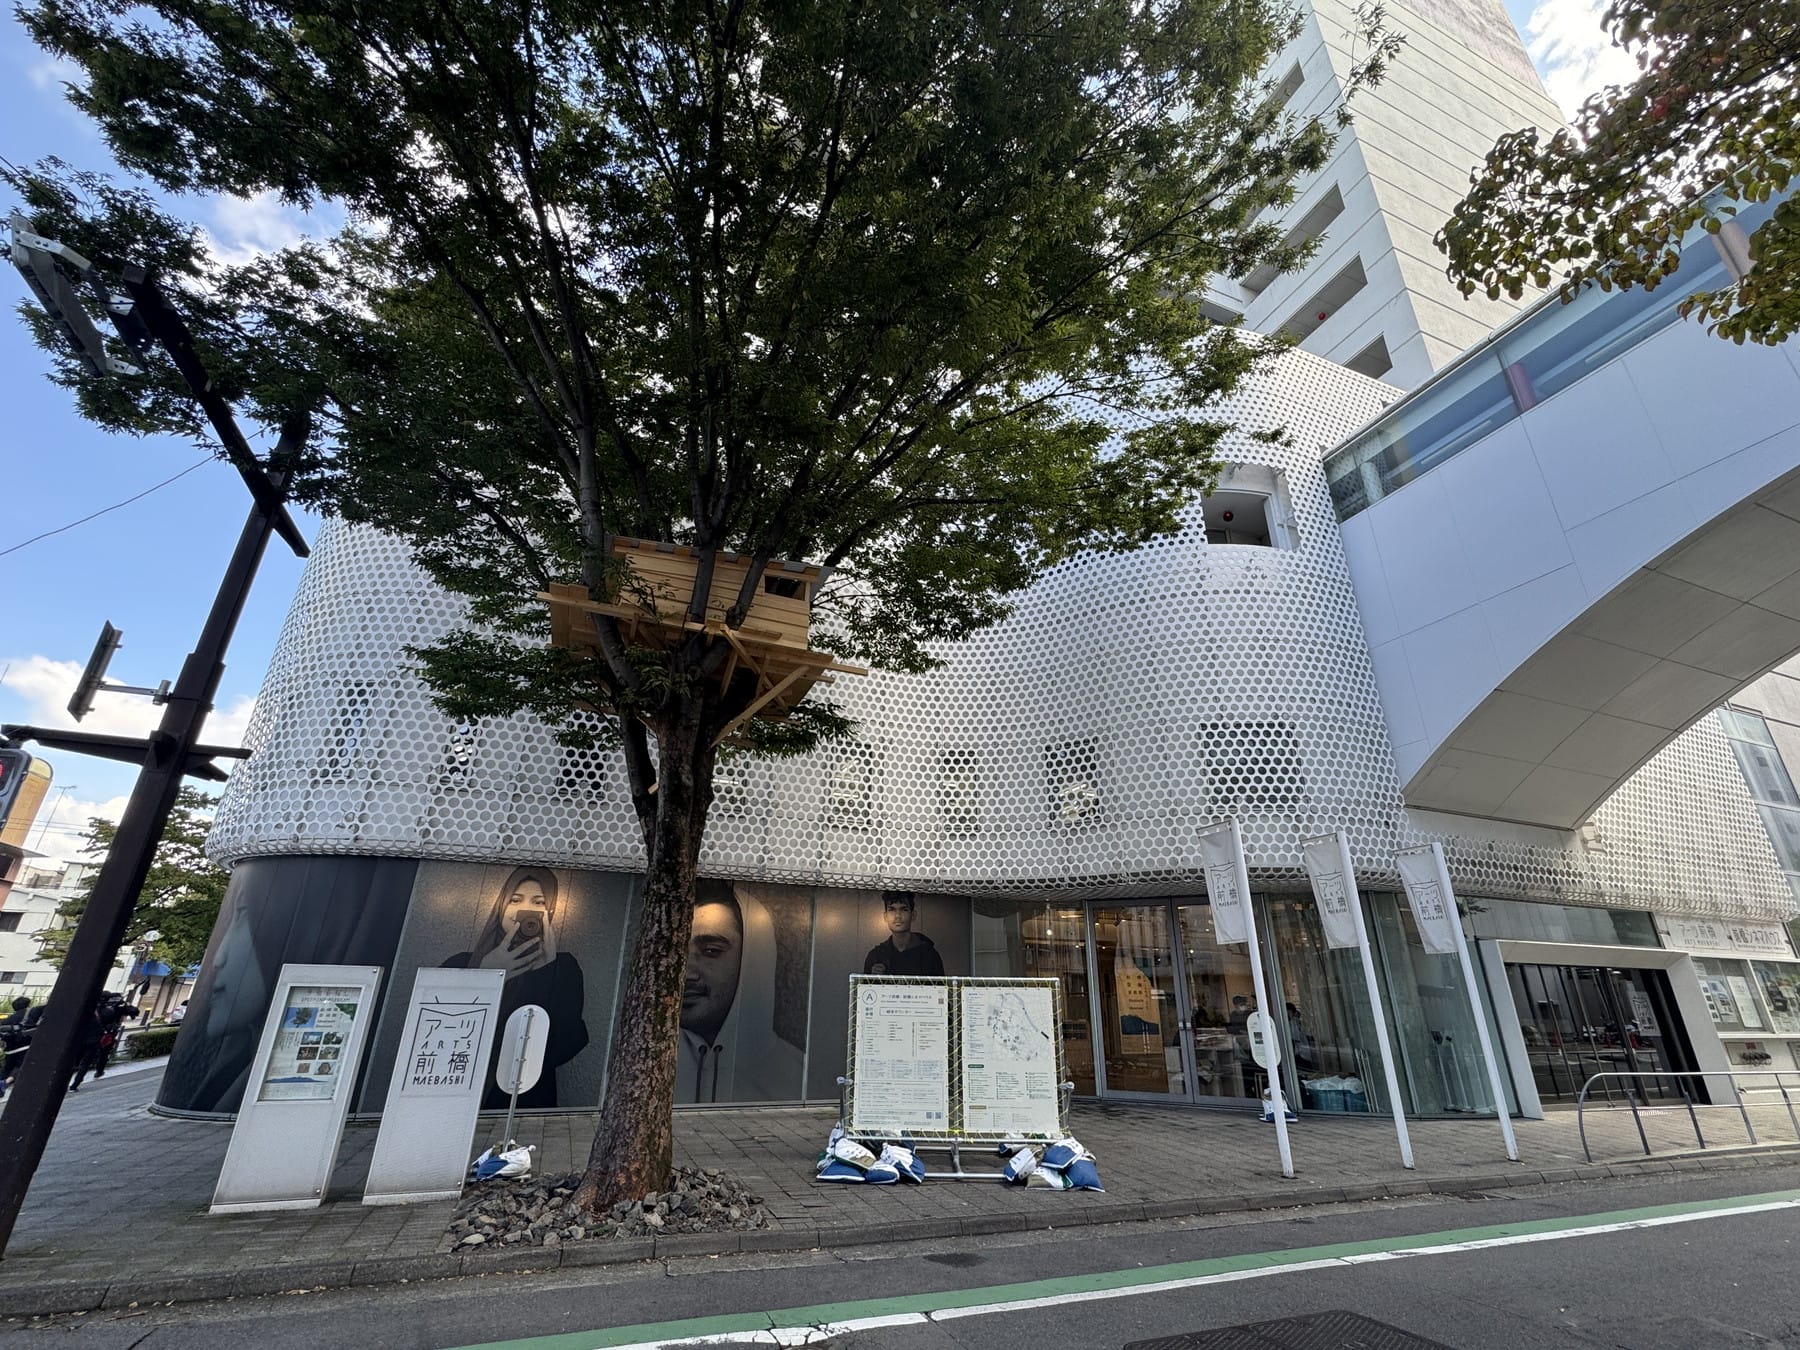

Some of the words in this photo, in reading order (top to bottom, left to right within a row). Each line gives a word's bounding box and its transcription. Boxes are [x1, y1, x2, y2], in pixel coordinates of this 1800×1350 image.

[865, 993, 874, 1001] A
[425, 1019, 476, 1040] アーツ
[421, 1040, 472, 1050] ARTS
[414, 1050, 471, 1075] 前橋
[412, 1075, 465, 1086] MAEBASHI
